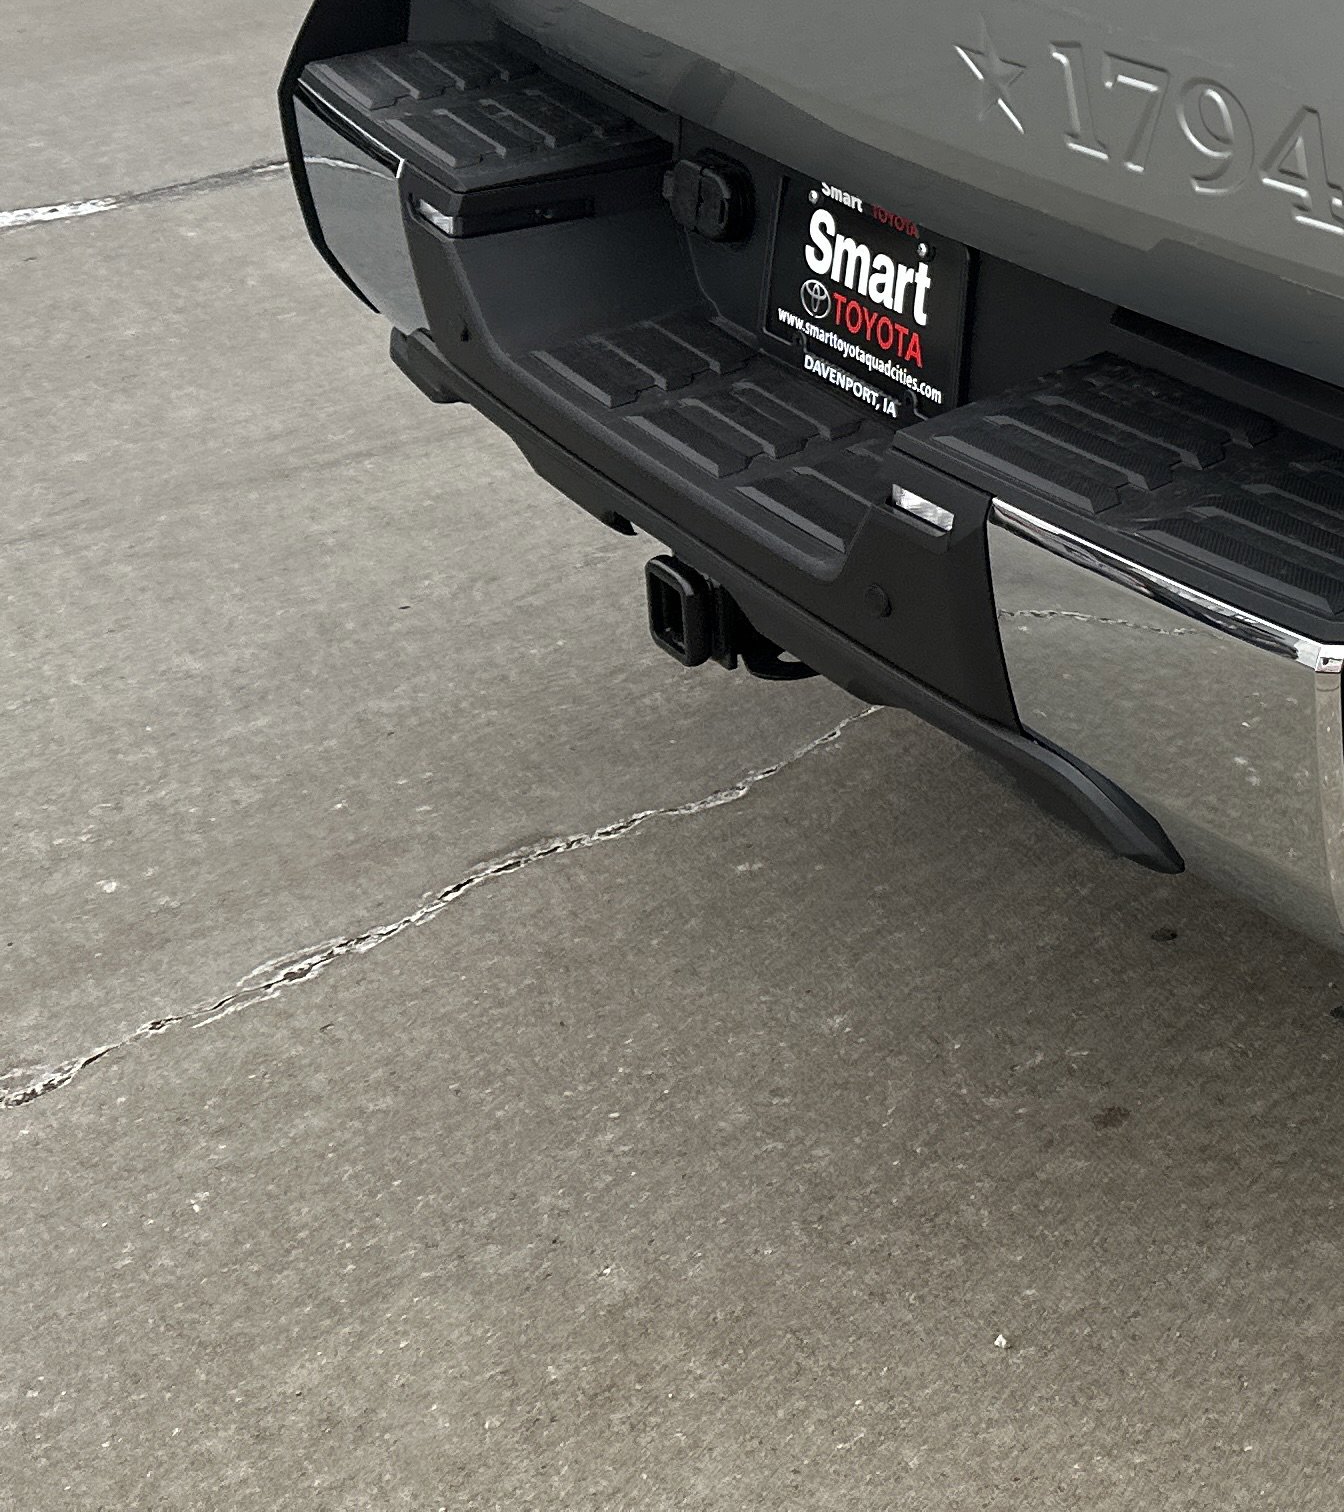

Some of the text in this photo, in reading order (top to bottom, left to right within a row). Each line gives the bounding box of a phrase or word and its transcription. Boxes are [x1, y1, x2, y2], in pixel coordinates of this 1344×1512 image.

[821, 181, 864, 214] Smart
[803, 208, 933, 326] Smart
[777, 306, 943, 405] www.smarttoyotaquadcities.com
[832, 291, 924, 369] TOYOTA
[803, 353, 898, 419] DAVENPORT, IA
